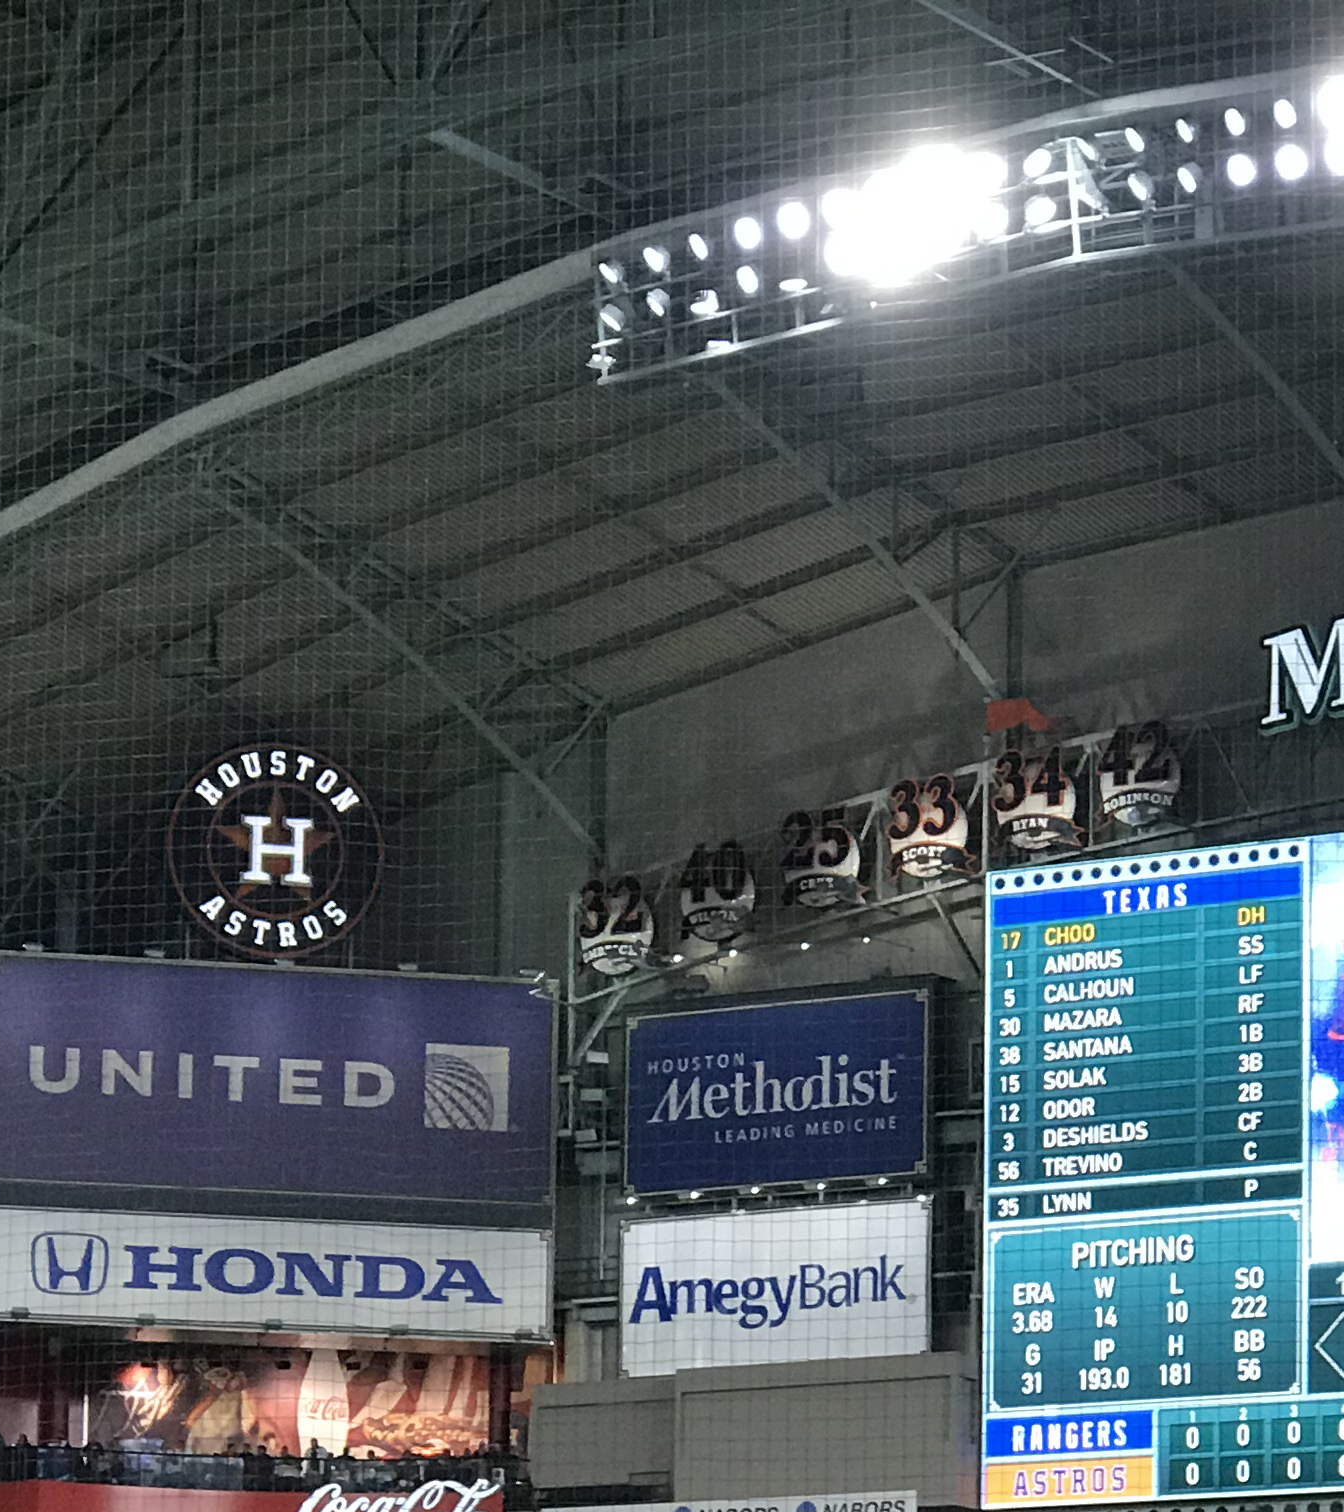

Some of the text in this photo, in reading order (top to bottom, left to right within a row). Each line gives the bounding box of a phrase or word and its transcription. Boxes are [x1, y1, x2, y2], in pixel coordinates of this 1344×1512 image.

[1098, 721, 1172, 787] 42
[194, 750, 361, 814] HOUSTON
[992, 746, 1068, 811] 34
[887, 773, 957, 839] 33
[781, 808, 850, 869] 25
[1012, 817, 1050, 832] RYAN
[238, 814, 315, 888] H
[902, 845, 947, 862] SCOTT
[580, 876, 642, 938] 32
[1103, 883, 1188, 914] TEXAS
[199, 895, 348, 948] ASTROS
[1001, 905, 1265, 950] 17 CHOO DH
[1043, 949, 1123, 975] ANDRUS
[1043, 976, 1134, 1004] CALHOUN
[1043, 1007, 1122, 1033] MAZARA
[647, 1053, 745, 1075] HOUSTON
[1043, 1035, 1133, 1062] SANTANA
[29, 1045, 395, 1109] UNITED
[646, 1053, 898, 1124] Methodist
[1043, 1066, 1107, 1091] SOLAK
[1043, 1097, 1095, 1120] ODOR
[714, 1116, 897, 1144] LEADING MEDICINE
[1042, 1121, 1149, 1149] DESHIELDS
[1042, 1152, 1123, 1177] TREVINO
[1042, 1192, 1092, 1215] LYNN
[1071, 1233, 1195, 1269] PITCHING
[123, 1243, 503, 1305] HONDA
[629, 1254, 907, 1330] AmegyBank
[1012, 1419, 1128, 1453] RANGERS
[1013, 1466, 1128, 1497] ASTROS
